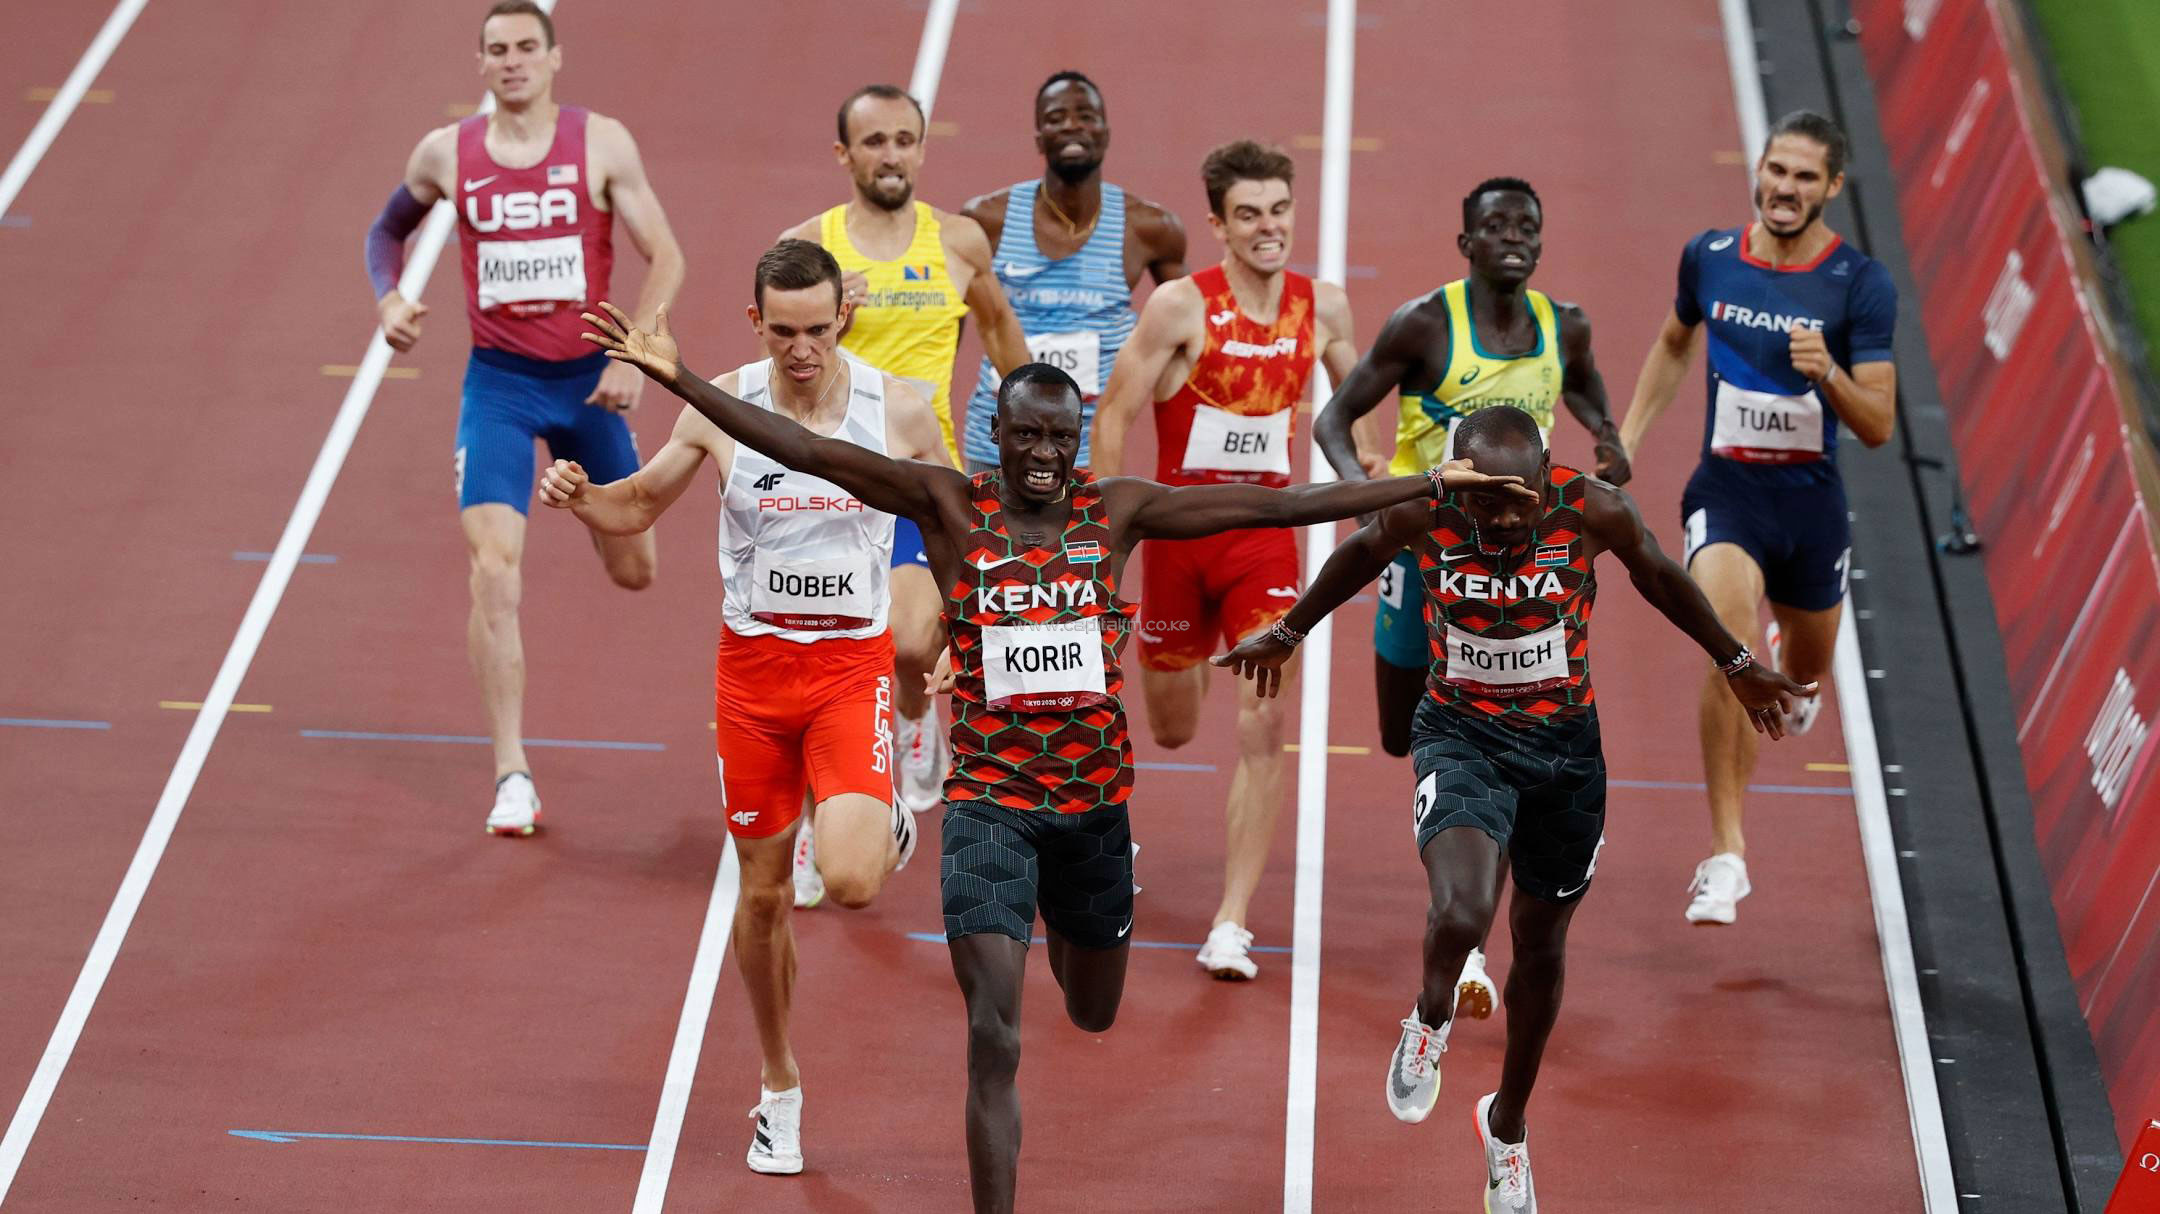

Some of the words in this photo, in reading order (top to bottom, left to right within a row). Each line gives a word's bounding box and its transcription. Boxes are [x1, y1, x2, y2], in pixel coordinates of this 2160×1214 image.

[465, 188, 578, 233] USA
[482, 254, 577, 283] MURPHY
[1723, 303, 1825, 334] FRANCE
[1736, 405, 1798, 433] TUAL
[1223, 431, 1270, 454] BEN
[752, 472, 786, 491] 4F
[758, 496, 864, 513] POLSKA
[769, 569, 855, 598] DOBEK
[977, 579, 1097, 614] KENYA
[1439, 570, 1565, 600] KENYA
[784, 617, 804, 626] TOKYO
[803, 619, 819, 627] 2020
[1005, 642, 1083, 673] KORIR
[1460, 640, 1552, 671] ROTICH
[1041, 698, 1057, 706] 2020
[871, 675, 891, 774] POLSKA
[730, 810, 760, 827] 4F
